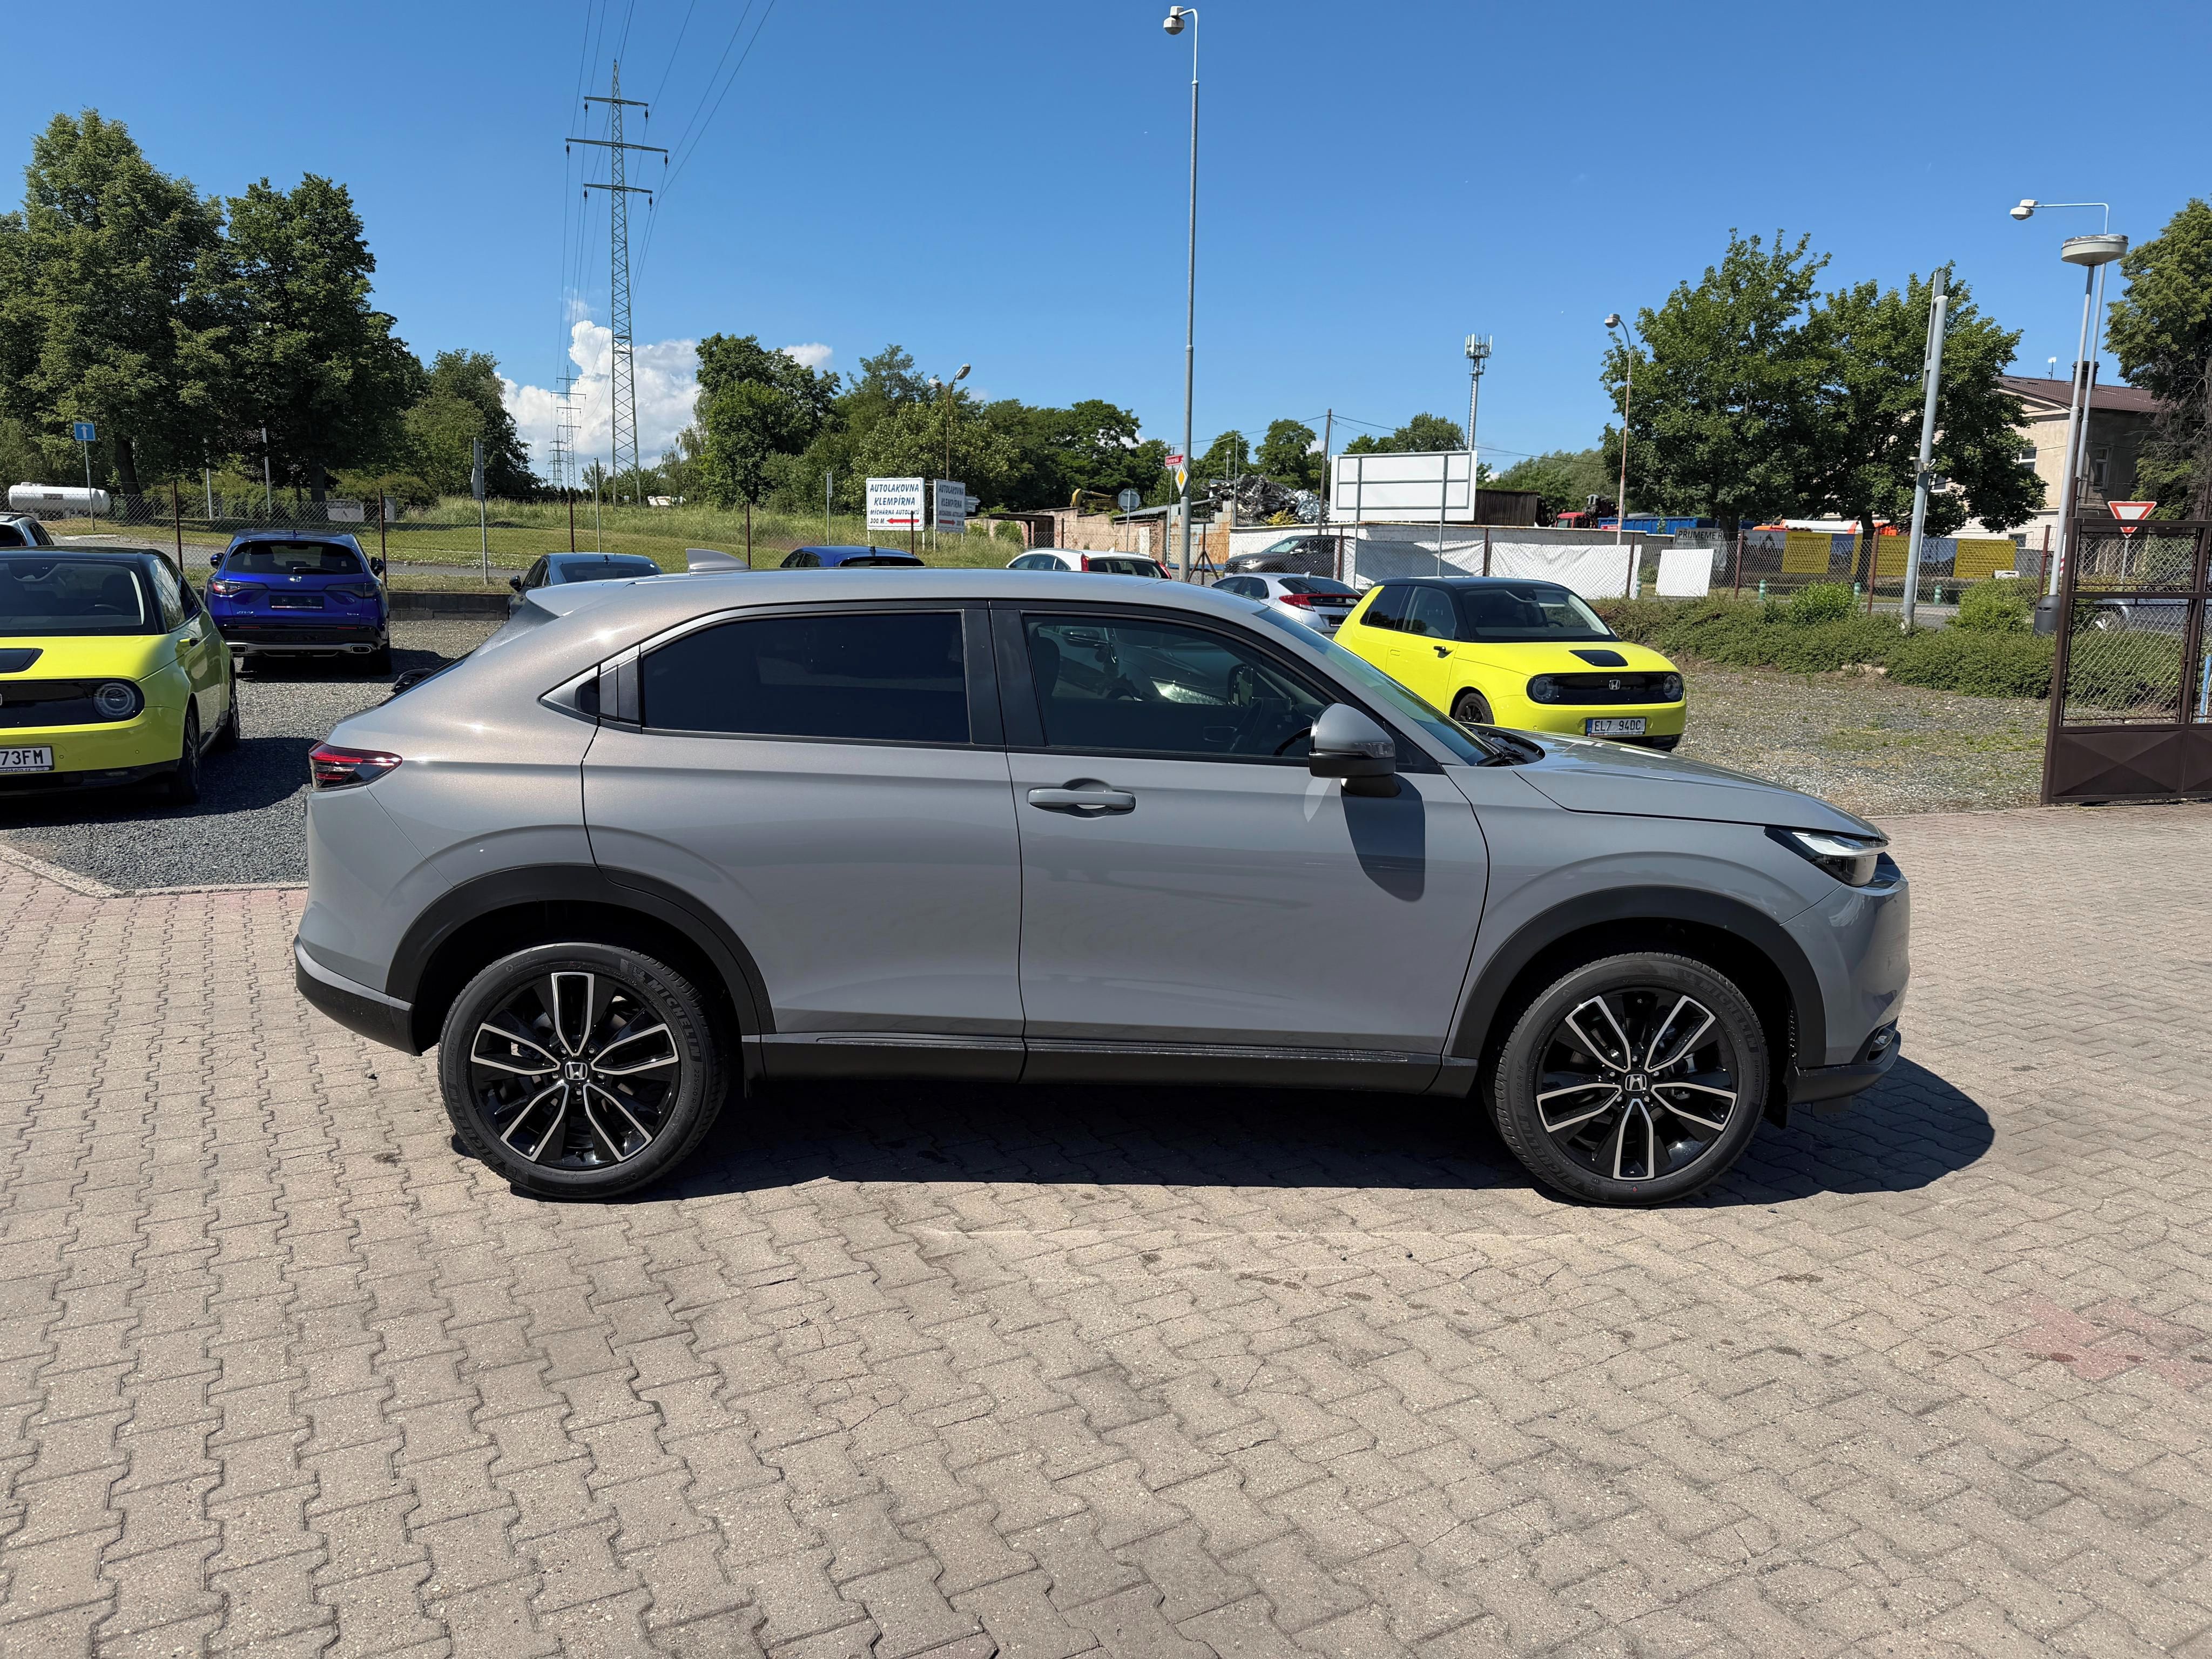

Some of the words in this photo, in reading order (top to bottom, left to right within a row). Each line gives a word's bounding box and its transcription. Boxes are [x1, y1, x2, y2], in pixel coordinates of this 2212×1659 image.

[870, 484, 919, 493] AUTOLAKOVNA
[874, 495, 915, 506] KLEMPÍRNA
[1595, 720, 1611, 731] EL7
[1618, 720, 1641, 730] 94DC
[0, 750, 44, 765] 73FM
[649, 979, 701, 1060] MICHELIN
[1700, 980, 1758, 1049] MICHELIN
[692, 1070, 700, 1096] 225/50
